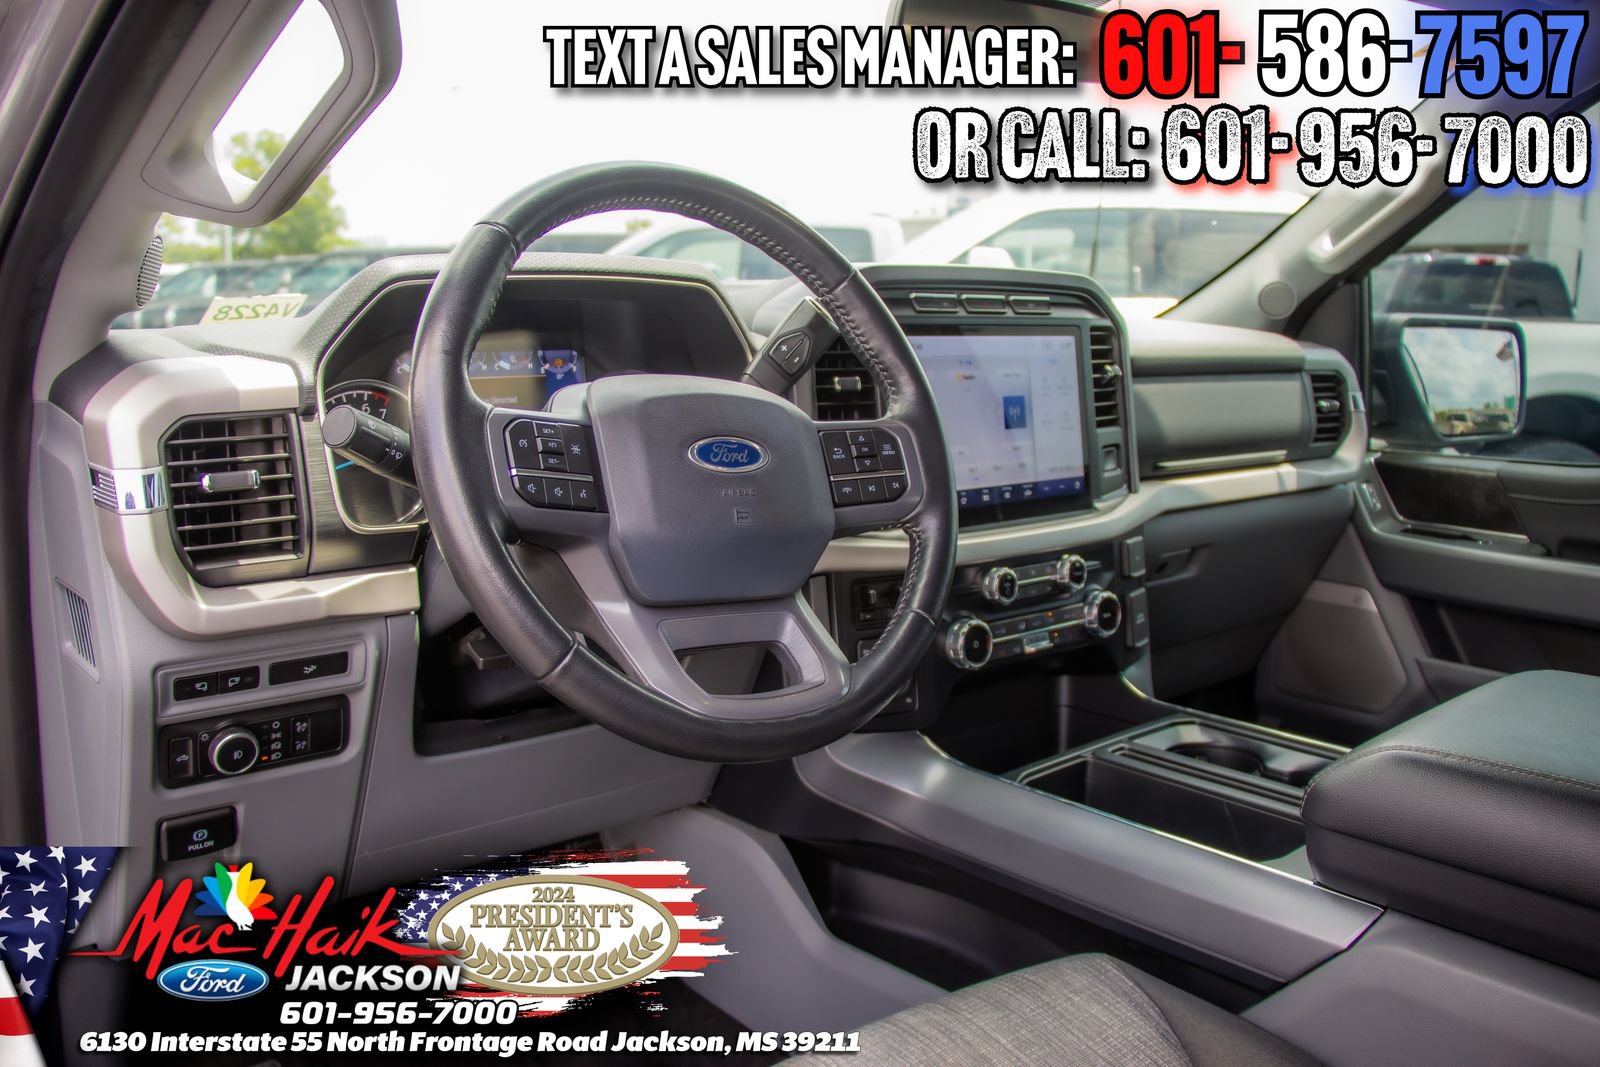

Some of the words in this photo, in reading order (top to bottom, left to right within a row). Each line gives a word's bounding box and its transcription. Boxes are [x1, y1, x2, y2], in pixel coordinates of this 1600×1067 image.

[361, 403, 371, 414] 6
[379, 408, 387, 419] 7
[710, 443, 750, 463] Ford
[187, 843, 203, 852] PULL
[203, 840, 215, 848] ON
